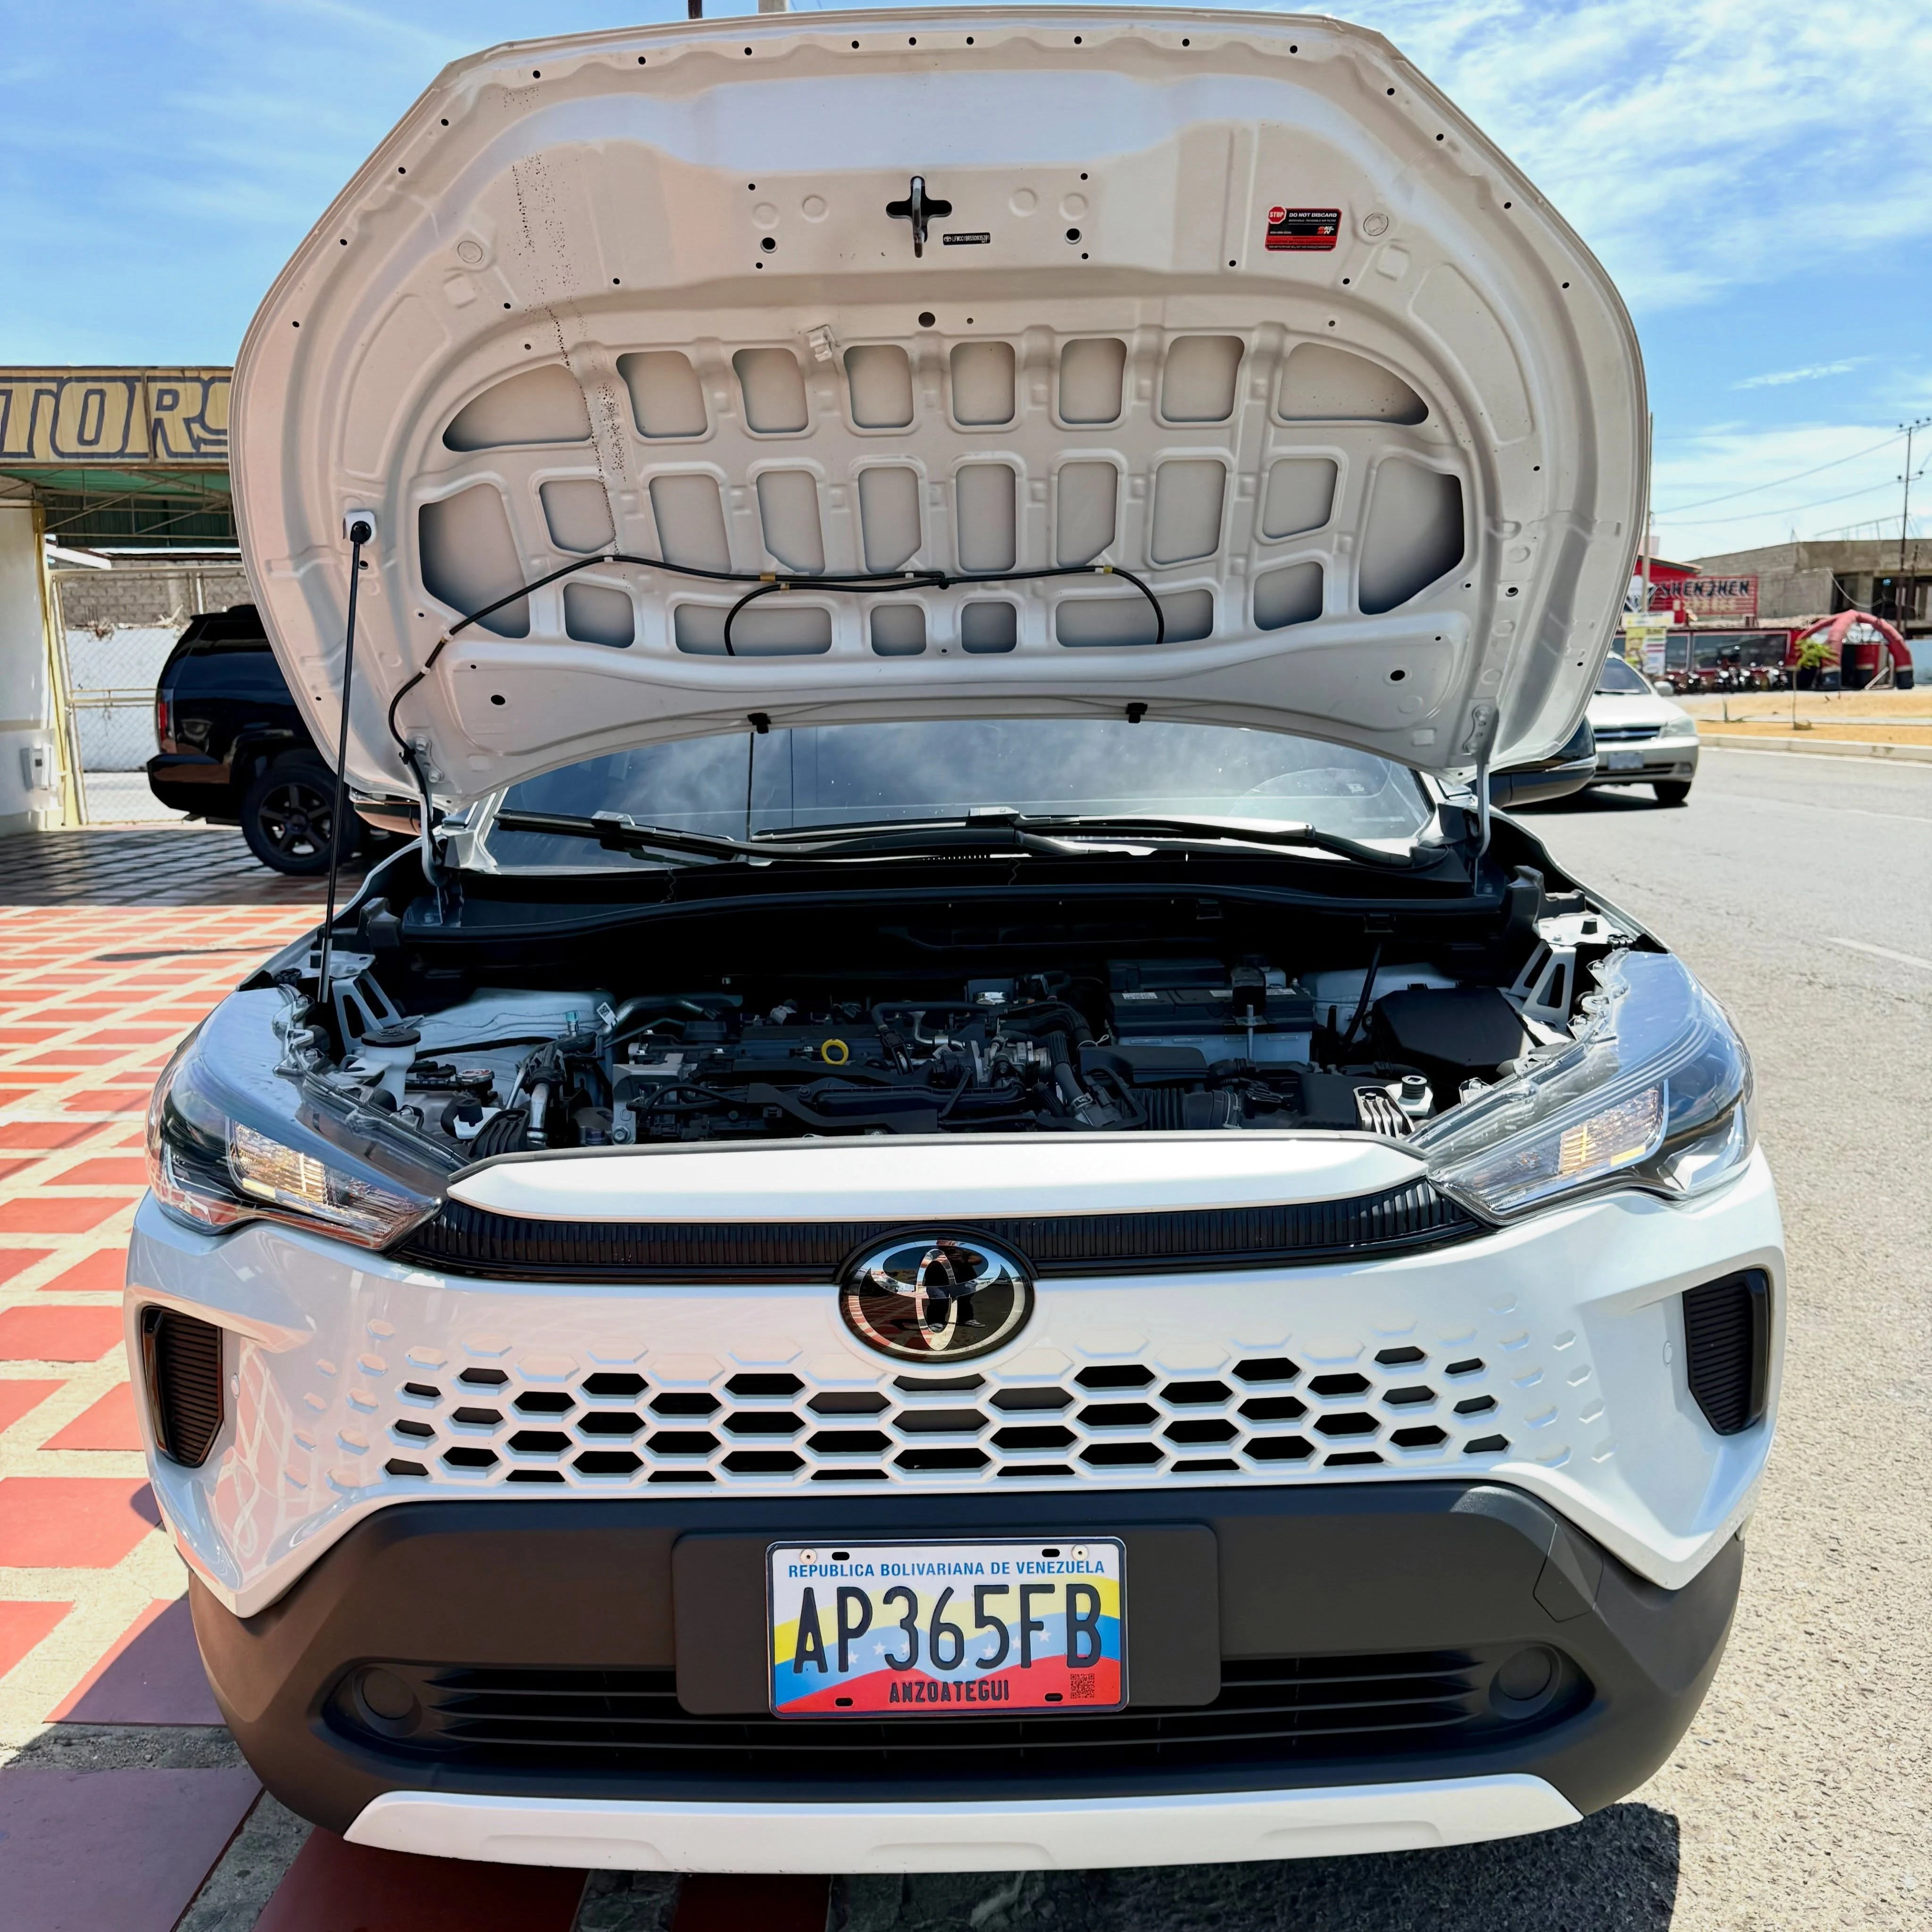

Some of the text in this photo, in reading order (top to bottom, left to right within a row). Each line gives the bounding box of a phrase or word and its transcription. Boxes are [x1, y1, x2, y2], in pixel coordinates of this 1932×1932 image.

[789, 1560, 1105, 1578] REPUBLICA BOLIVARIANA DE VENEZUELA
[793, 1583, 1102, 1674] AP365FB
[890, 1680, 1009, 1703] ANZOATEGUI
